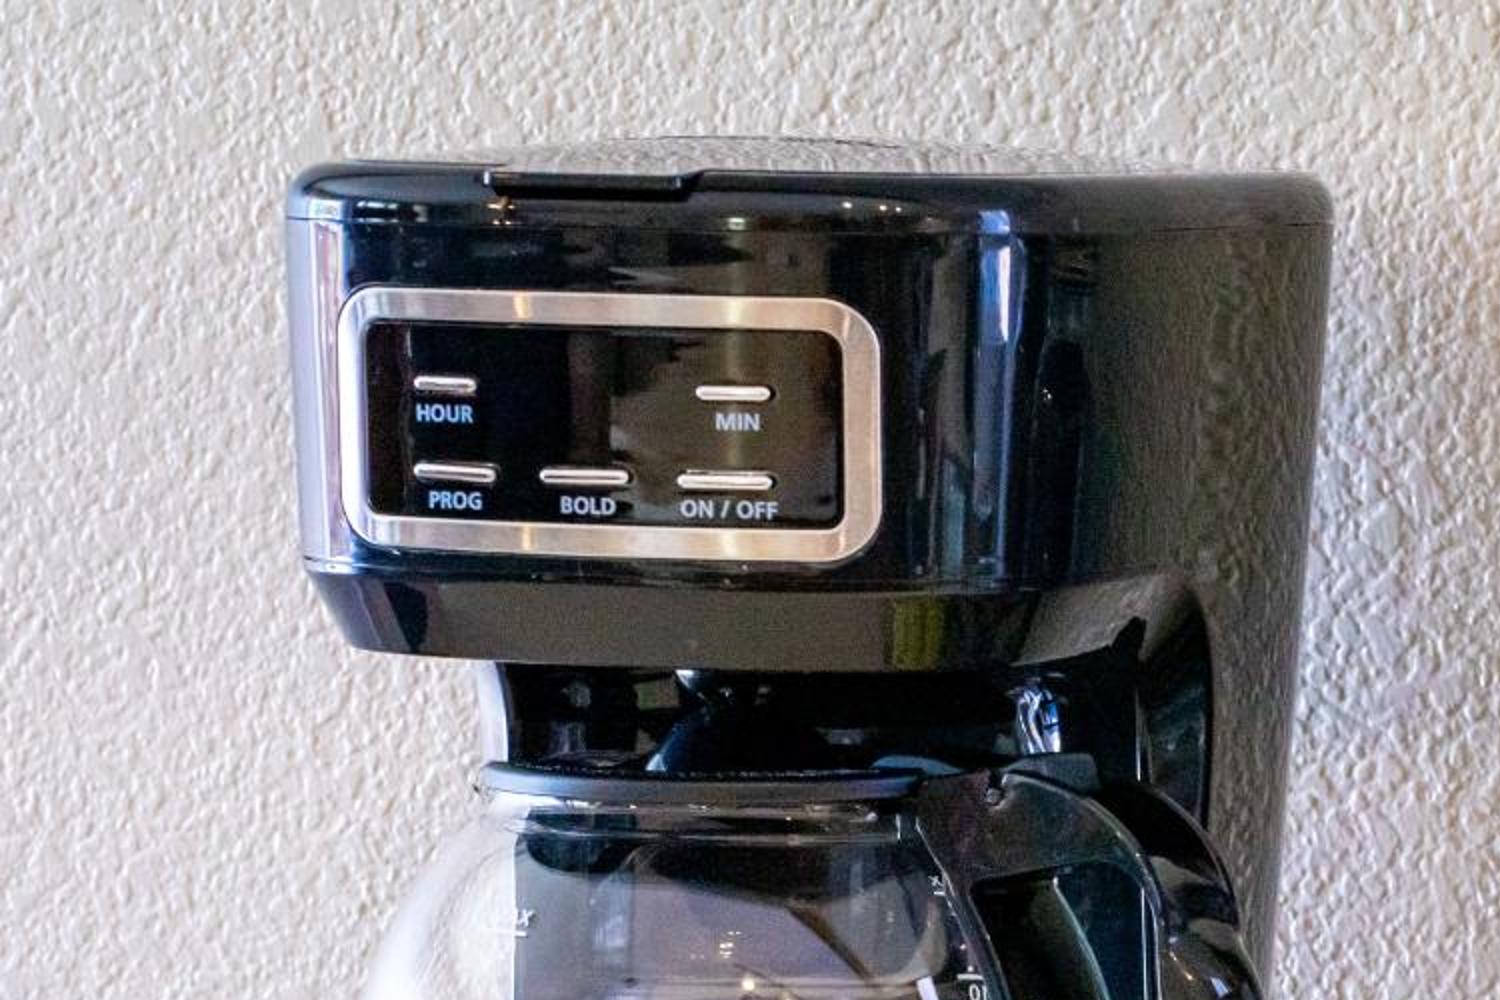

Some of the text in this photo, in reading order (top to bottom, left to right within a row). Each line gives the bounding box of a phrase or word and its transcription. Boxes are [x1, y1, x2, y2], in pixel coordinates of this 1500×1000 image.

[416, 403, 474, 424] HOUR
[716, 412, 761, 432] MIN
[428, 491, 483, 511] PROG
[560, 496, 617, 517] BOLD
[680, 500, 779, 521] ON / OFF
